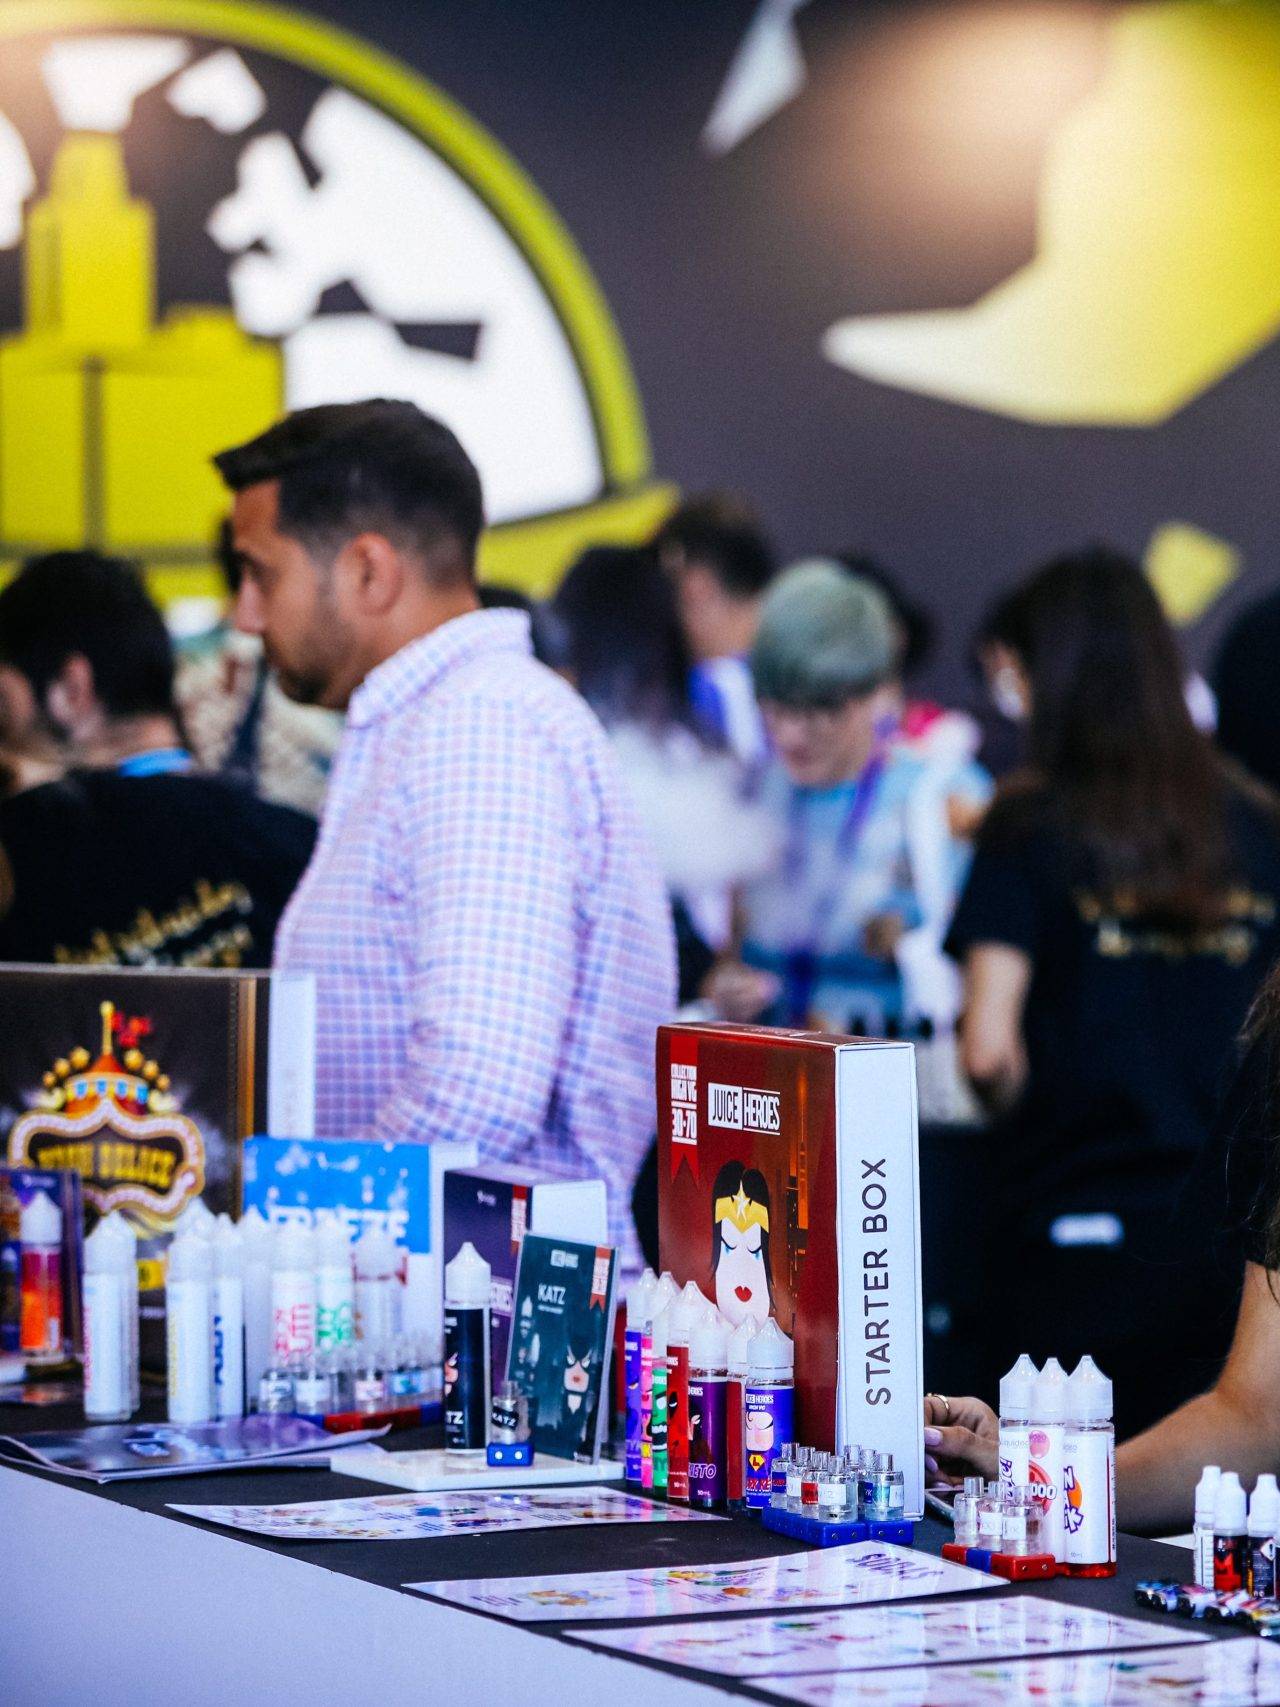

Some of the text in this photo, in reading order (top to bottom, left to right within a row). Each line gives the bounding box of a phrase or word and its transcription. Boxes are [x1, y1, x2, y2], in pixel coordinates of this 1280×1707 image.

[713, 1089, 780, 1130] JUICE HEROES
[861, 1158, 892, 1405] STARTER BOX
[537, 1283, 566, 1305] KATZ
[445, 1410, 464, 1425] TZ
[688, 1463, 717, 1479] NETO
